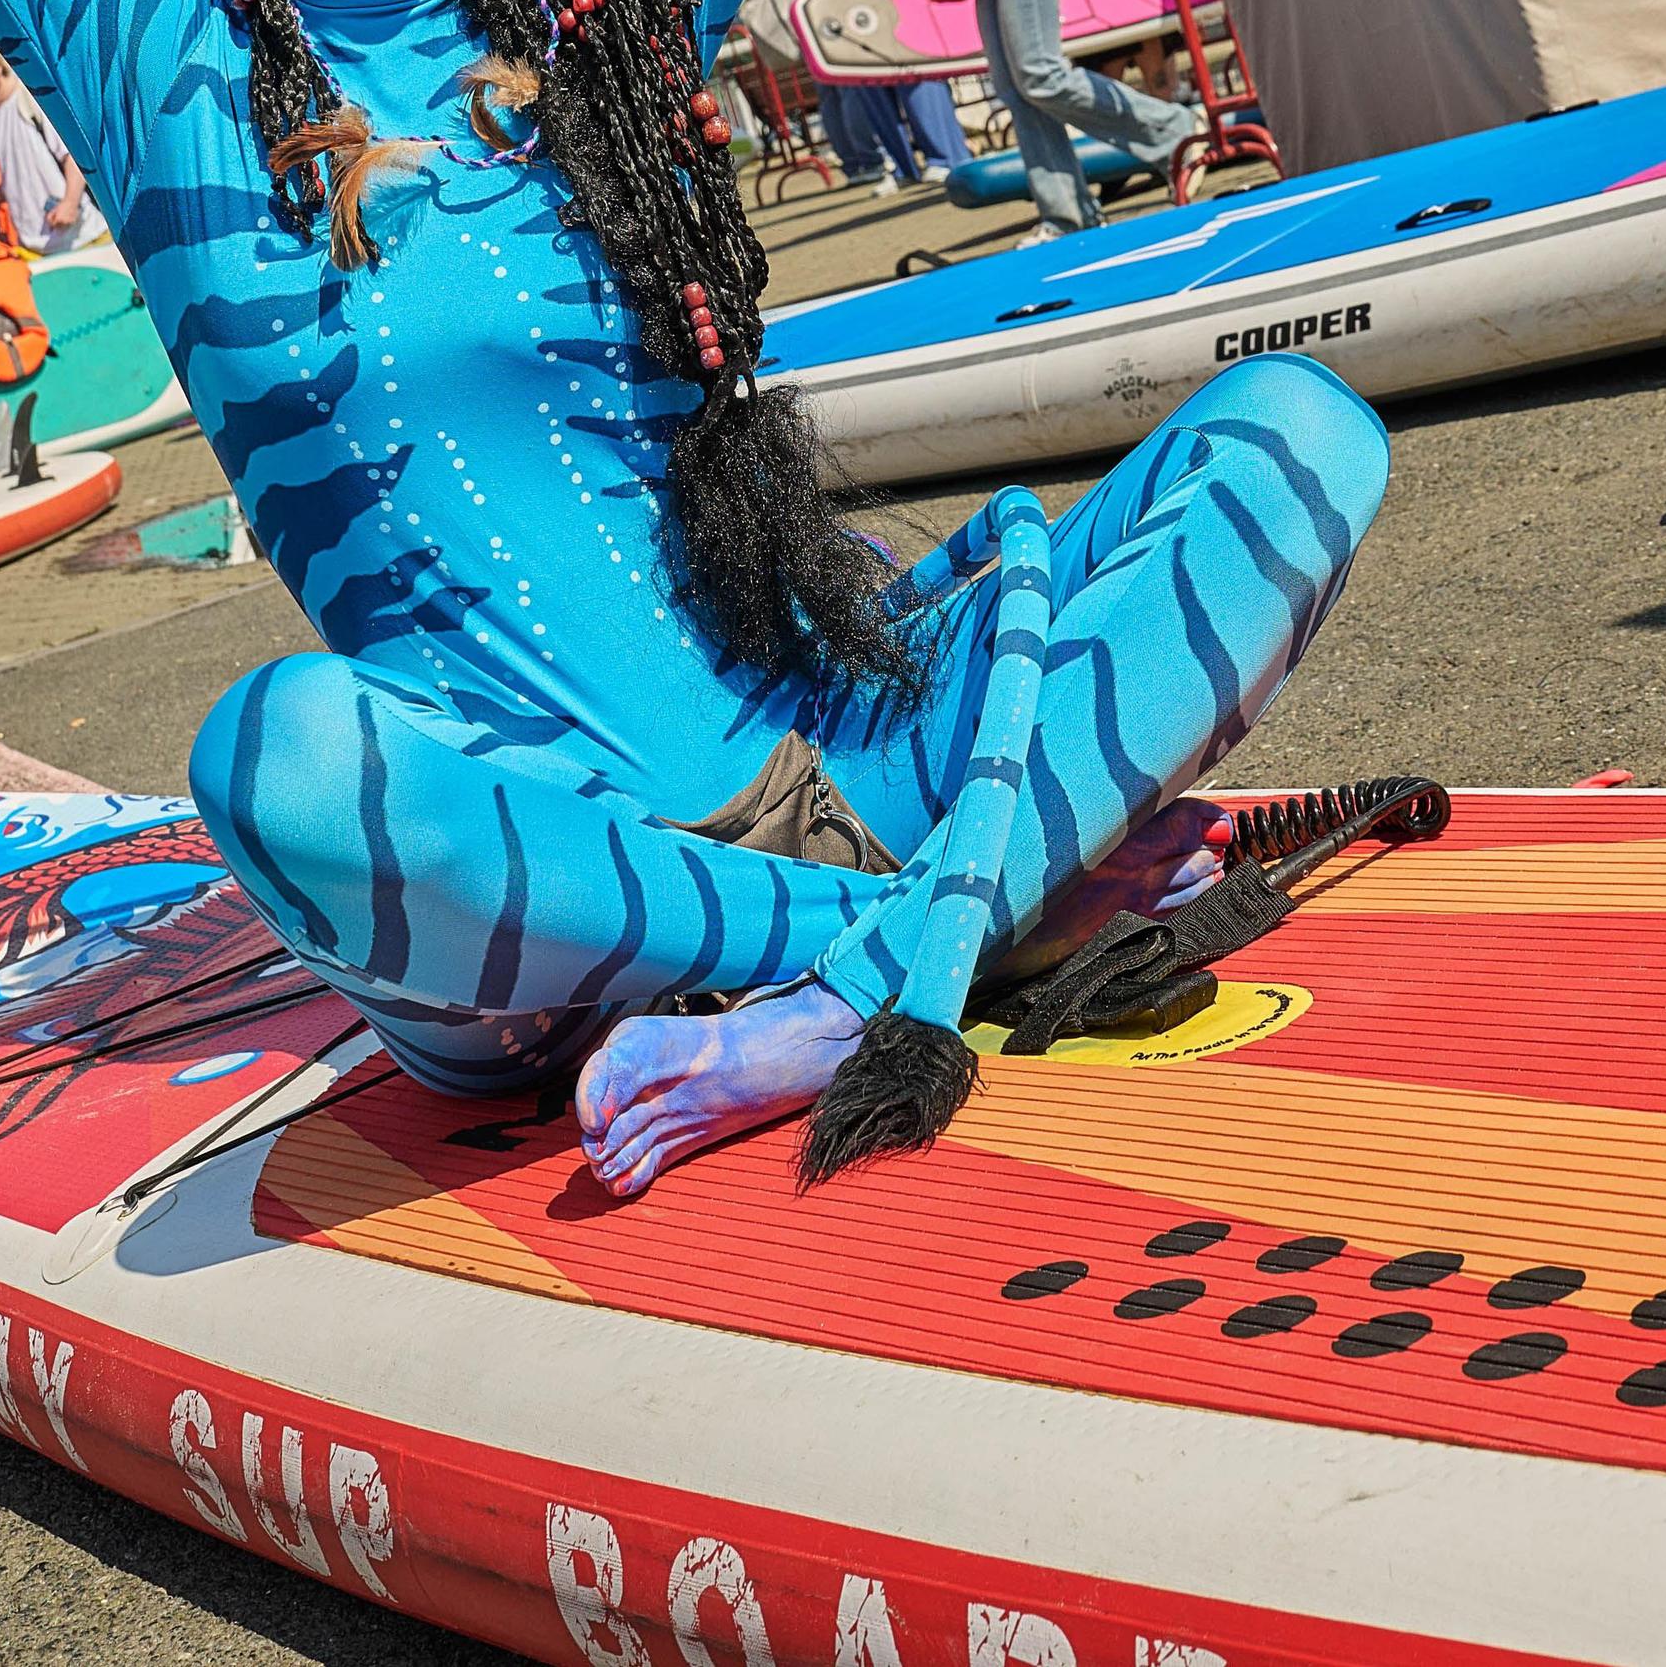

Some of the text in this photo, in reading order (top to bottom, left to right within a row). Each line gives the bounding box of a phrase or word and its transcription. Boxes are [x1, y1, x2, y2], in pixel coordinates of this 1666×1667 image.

[1216, 303, 1371, 362] COOPER
[1153, 1051, 1178, 1061] The
[1183, 1038, 1234, 1056] Paddle
[169, 1389, 399, 1604] SUP
